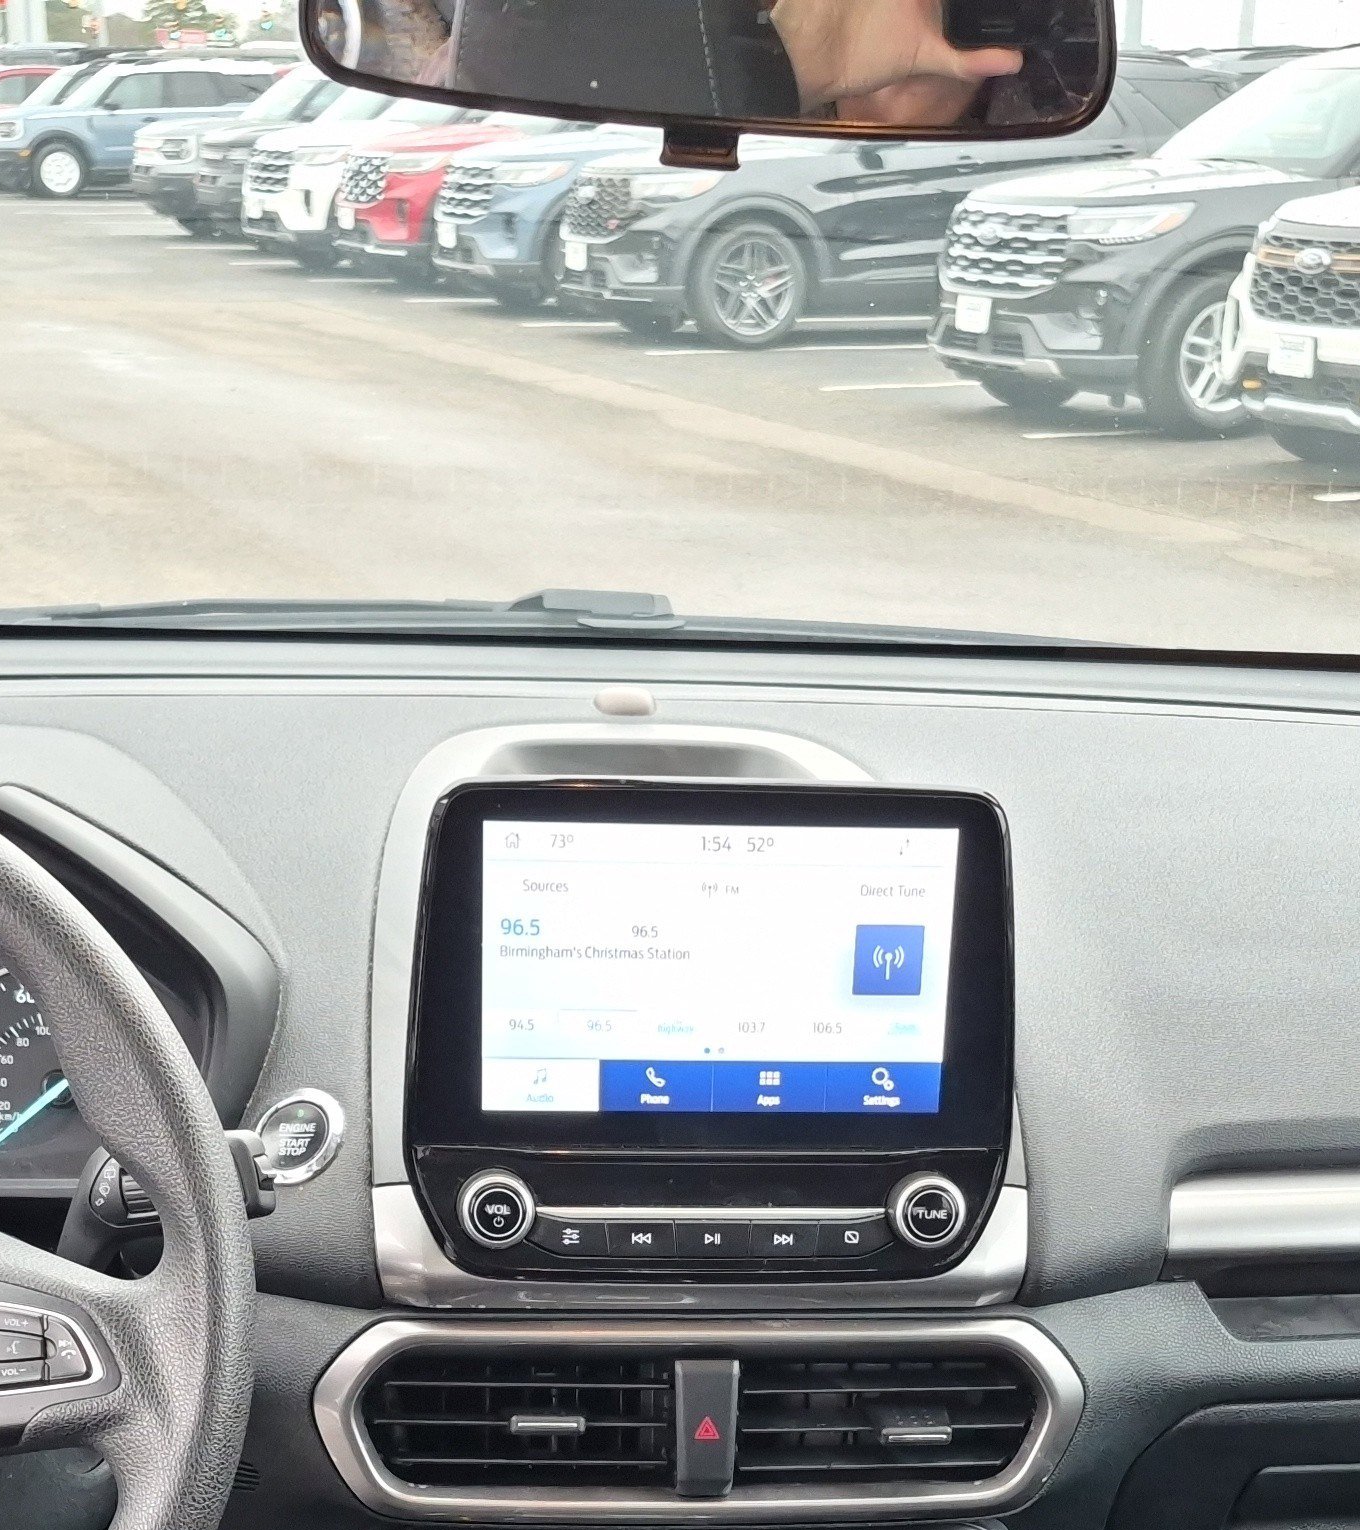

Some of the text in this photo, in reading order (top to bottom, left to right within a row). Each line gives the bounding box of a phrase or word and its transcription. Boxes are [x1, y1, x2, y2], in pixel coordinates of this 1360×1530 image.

[701, 836, 732, 852] 1:54
[522, 879, 569, 892] Sources
[726, 885, 740, 895] FM
[860, 884, 926, 897] Direct Tune
[500, 918, 540, 936] 96.5
[631, 925, 659, 938] 96.5
[500, 945, 691, 960] Birmingham's Christmas Station
[509, 1019, 535, 1031] 94.5
[586, 1019, 613, 1032] 96.5
[738, 1021, 765, 1033] 103.7
[813, 1021, 842, 1034] 106.5
[16, 1037, 29, 1047] 80
[1, 1055, 13, 1065] 60
[526, 1093, 554, 1103] Audio
[640, 1093, 670, 1105] Phone
[757, 1094, 780, 1107] Apps
[863, 1095, 900, 1107] Settings
[279, 1122, 317, 1133] ENGINE
[279, 1138, 311, 1148] START
[278, 1147, 307, 1156] STOP
[485, 1203, 510, 1216] VOL
[916, 1208, 948, 1220] TUNE
